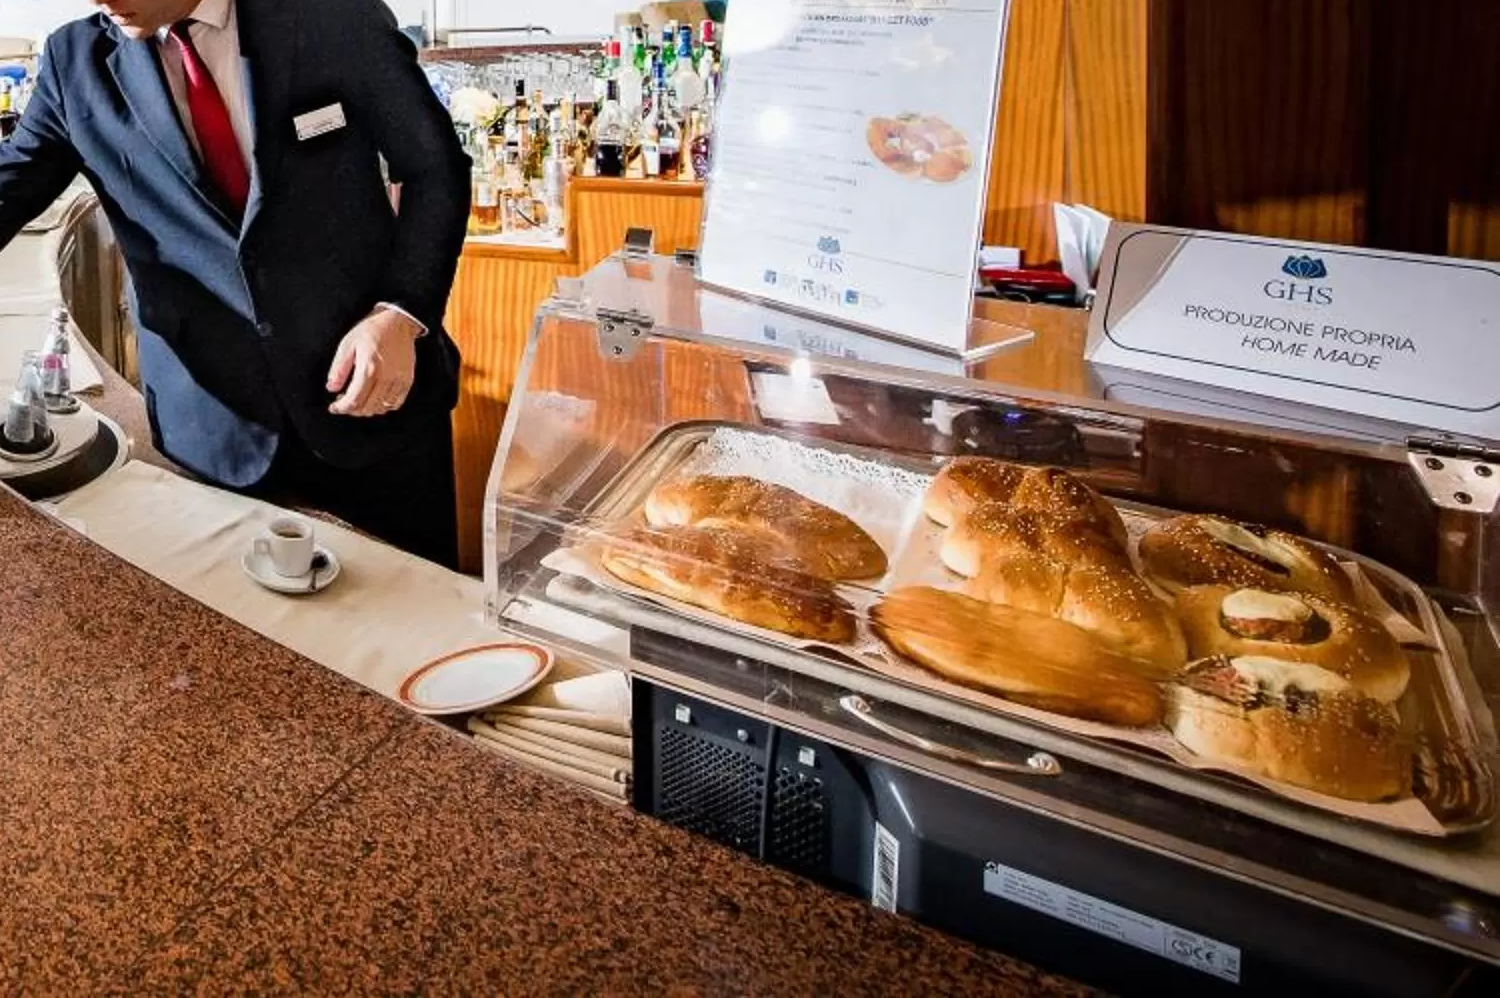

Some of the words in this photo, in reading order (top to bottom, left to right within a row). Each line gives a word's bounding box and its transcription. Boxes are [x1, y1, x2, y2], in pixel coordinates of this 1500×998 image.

[807, 253, 844, 275] GHS
[1263, 278, 1333, 306] GHS
[1183, 304, 1315, 338] PRODUZIONE
[1321, 324, 1417, 353] PROPRIA
[1240, 334, 1308, 358] HOME
[1312, 347, 1382, 370] MADE
